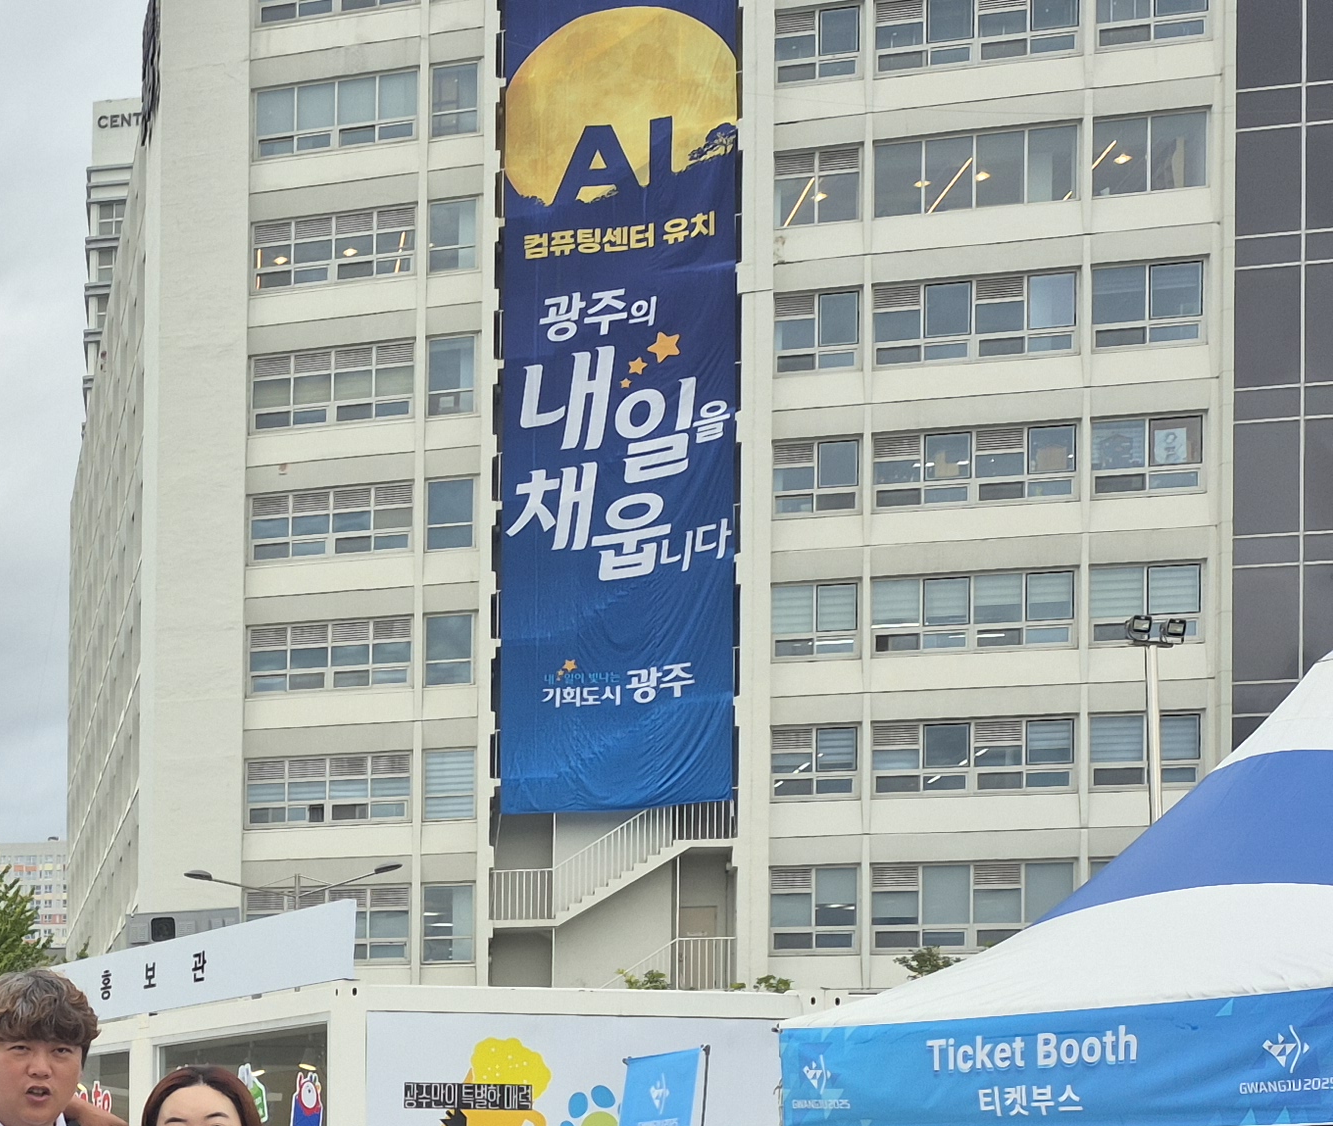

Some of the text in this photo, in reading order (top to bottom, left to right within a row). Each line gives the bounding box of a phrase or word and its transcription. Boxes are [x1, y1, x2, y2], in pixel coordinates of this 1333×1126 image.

[97, 112, 142, 129] CENT
[550, 116, 676, 207] AI
[523, 211, 716, 260] 컴퓨팅센터 유치
[539, 288, 657, 342] 광주의
[506, 462, 732, 581] 채웁니다
[541, 662, 696, 709] 기회도시 광주
[926, 1024, 1138, 1072] Ticket Booth
[404, 1083, 532, 1109] 광주만의 특별한 매력
[978, 1083, 1084, 1117] 티켓부스
[1238, 1078, 1302, 1095] GWANGJU
